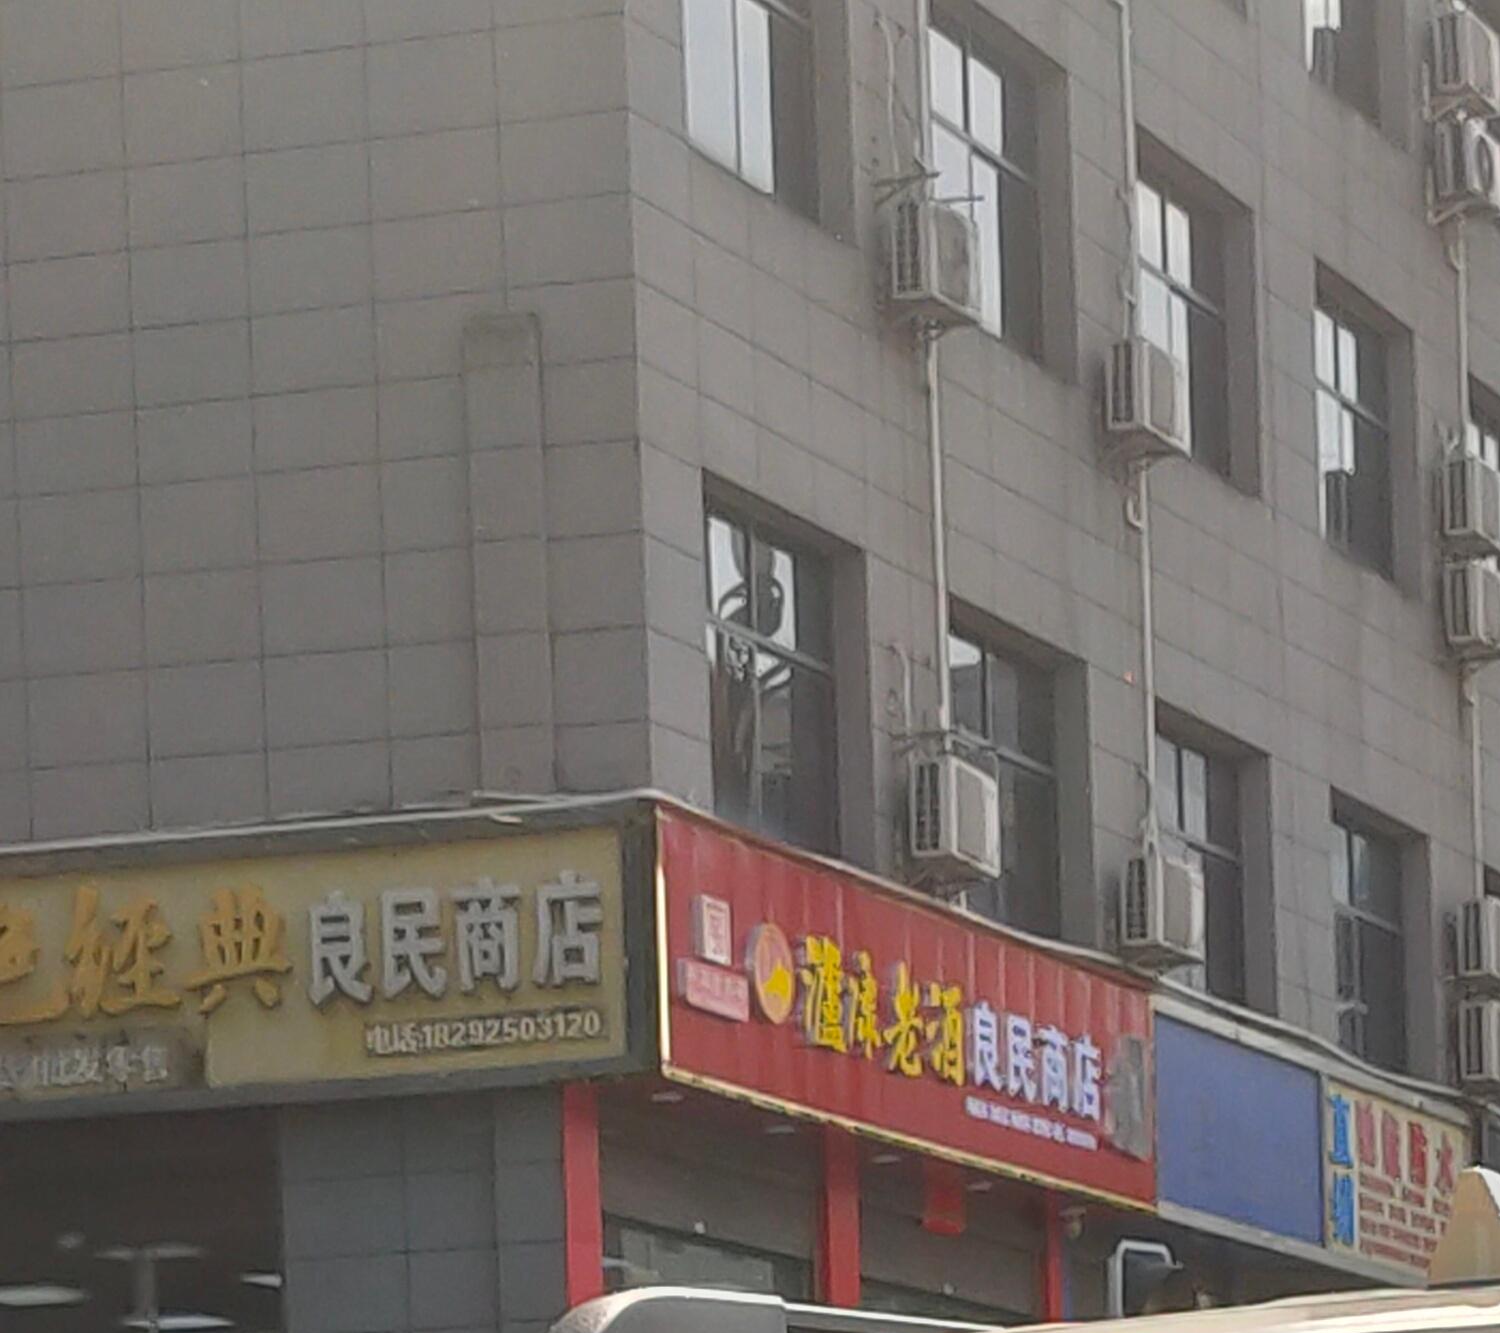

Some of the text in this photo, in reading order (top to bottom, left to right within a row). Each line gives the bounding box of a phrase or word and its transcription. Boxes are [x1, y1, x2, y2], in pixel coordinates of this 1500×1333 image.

[306, 869, 604, 1004] 良民商店
[970, 1001, 1101, 1122] 良民商店
